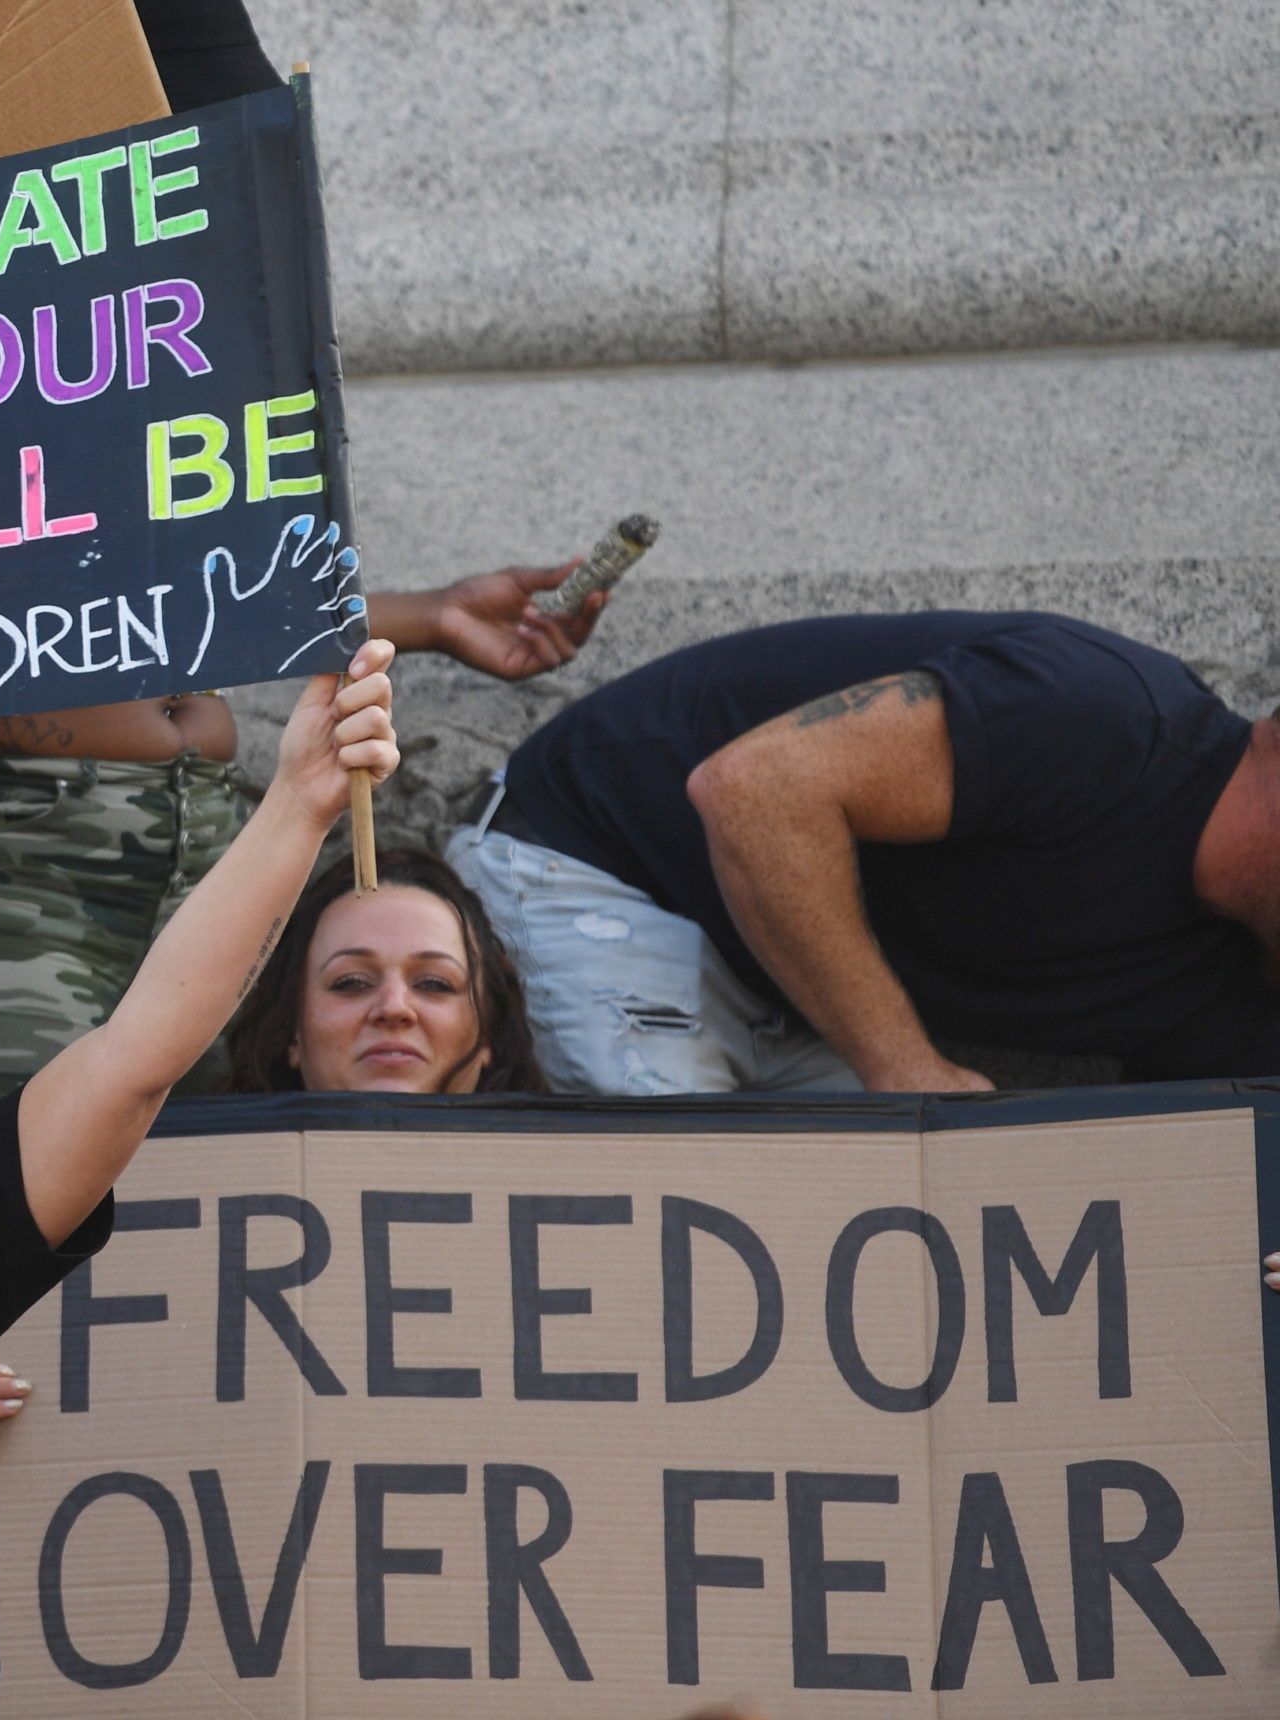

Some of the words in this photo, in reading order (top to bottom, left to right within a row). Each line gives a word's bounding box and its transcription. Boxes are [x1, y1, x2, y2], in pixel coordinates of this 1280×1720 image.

[146, 389, 327, 522] BE
[59, 1189, 1133, 1414] FREEDOM
[37, 1459, 595, 1690] OVER
[661, 1457, 1228, 1693] FEAR
